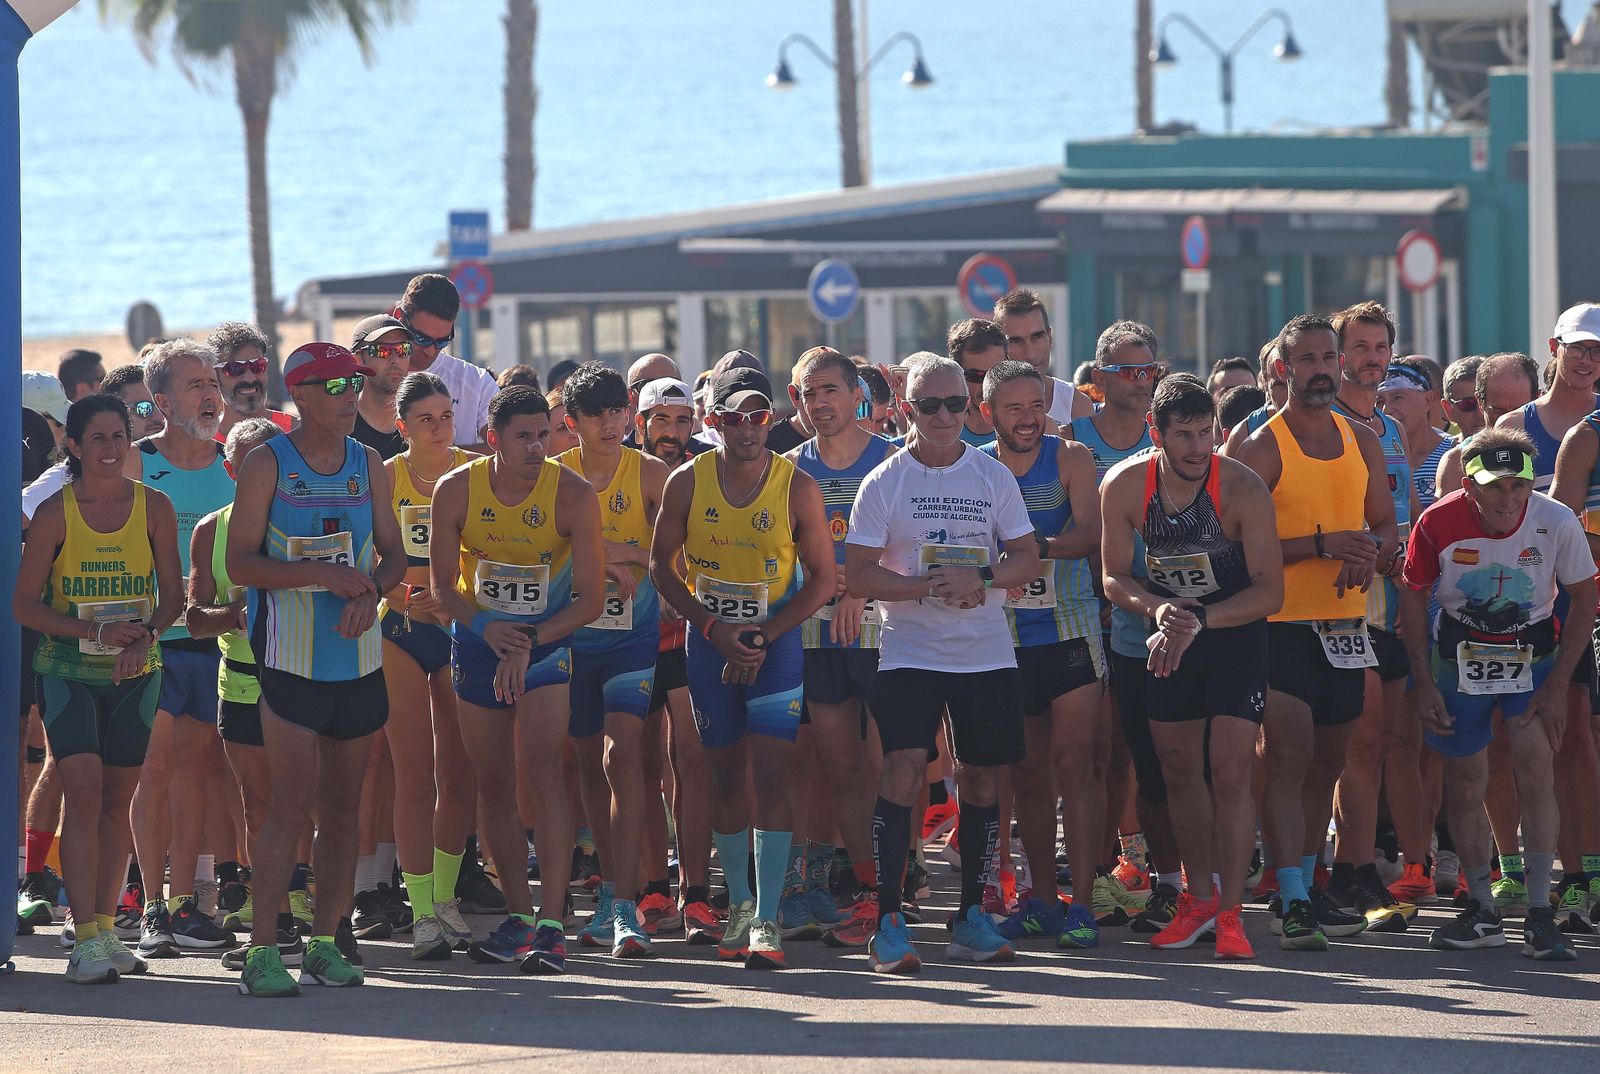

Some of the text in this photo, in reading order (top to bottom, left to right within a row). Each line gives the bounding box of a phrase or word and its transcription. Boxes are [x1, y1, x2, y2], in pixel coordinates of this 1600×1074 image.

[943, 497, 992, 508] EDICIÓN
[954, 505, 983, 514] URBANA
[950, 513, 987, 523] ALGECIRAS
[80, 560, 126, 572] RUNNERS
[62, 572, 152, 597] BARREÑOS
[1151, 569, 1208, 586] 212
[482, 580, 540, 602] 315
[703, 593, 759, 618] 325
[1325, 635, 1366, 655] 339
[1466, 660, 1524, 680] 327
[977, 820, 999, 884] kalenji
